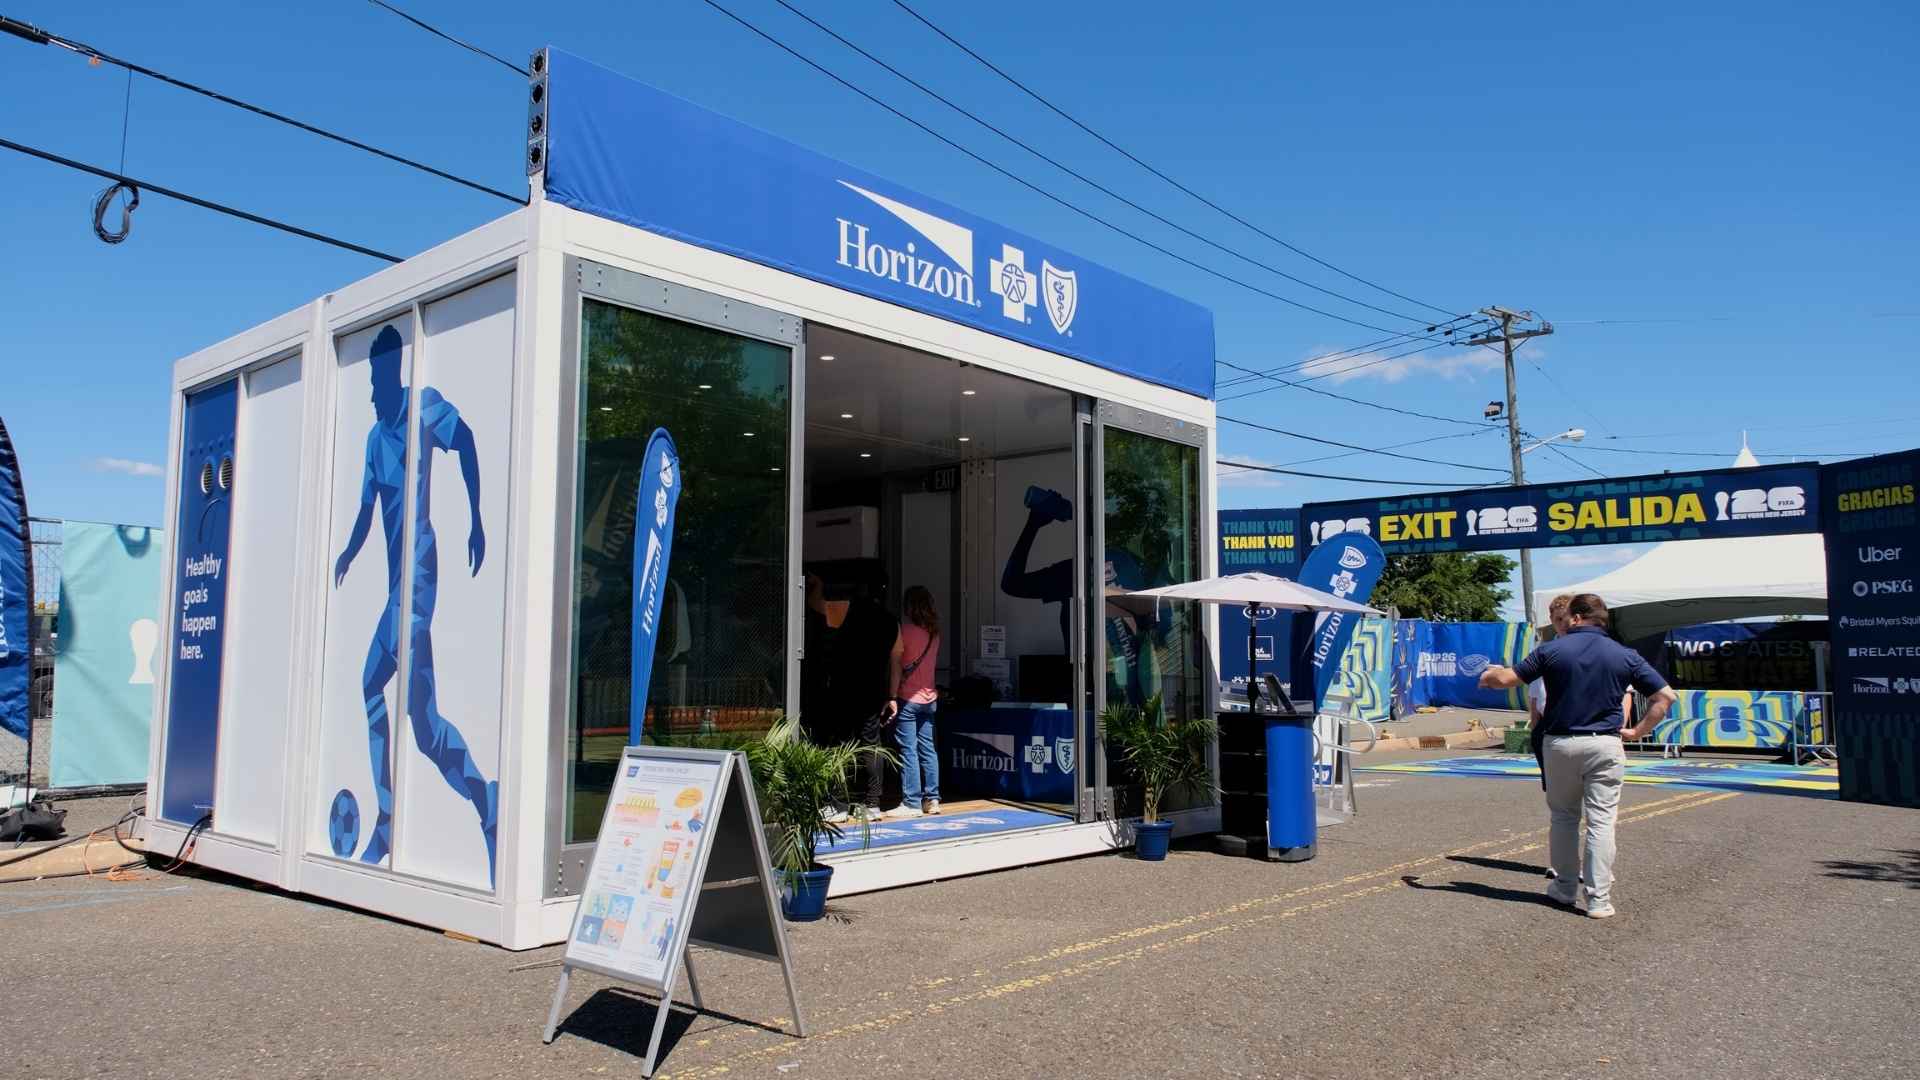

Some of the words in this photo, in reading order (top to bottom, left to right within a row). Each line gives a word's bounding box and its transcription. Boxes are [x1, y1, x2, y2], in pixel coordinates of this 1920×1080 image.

[836, 217, 976, 306] Horizon
[1838, 484, 1914, 512] GRACIAS
[1548, 493, 1707, 532] SALIDA
[1223, 520, 1265, 534] THANK
[1269, 519, 1294, 533] YOU
[1379, 511, 1457, 542] EXIT
[1222, 536, 1265, 549] THANK
[1268, 535, 1294, 548] YOU
[1223, 551, 1265, 565] THANK
[1268, 550, 1294, 564] YOU
[1858, 546, 1902, 563] Uber
[185, 553, 222, 579] Healthy
[183, 582, 208, 610] goals
[641, 544, 663, 636] Horizon
[1872, 579, 1913, 594] PSEG
[182, 612, 216, 637] happen
[1850, 617, 1875, 627] Bristol
[1876, 616, 1900, 628] Myers
[180, 640, 203, 660] here.
[1442, 652, 1457, 662] 26
[1664, 640, 1716, 657] TWO
[1853, 683, 1889, 694] Horizon
[952, 747, 1016, 773] Horizon
